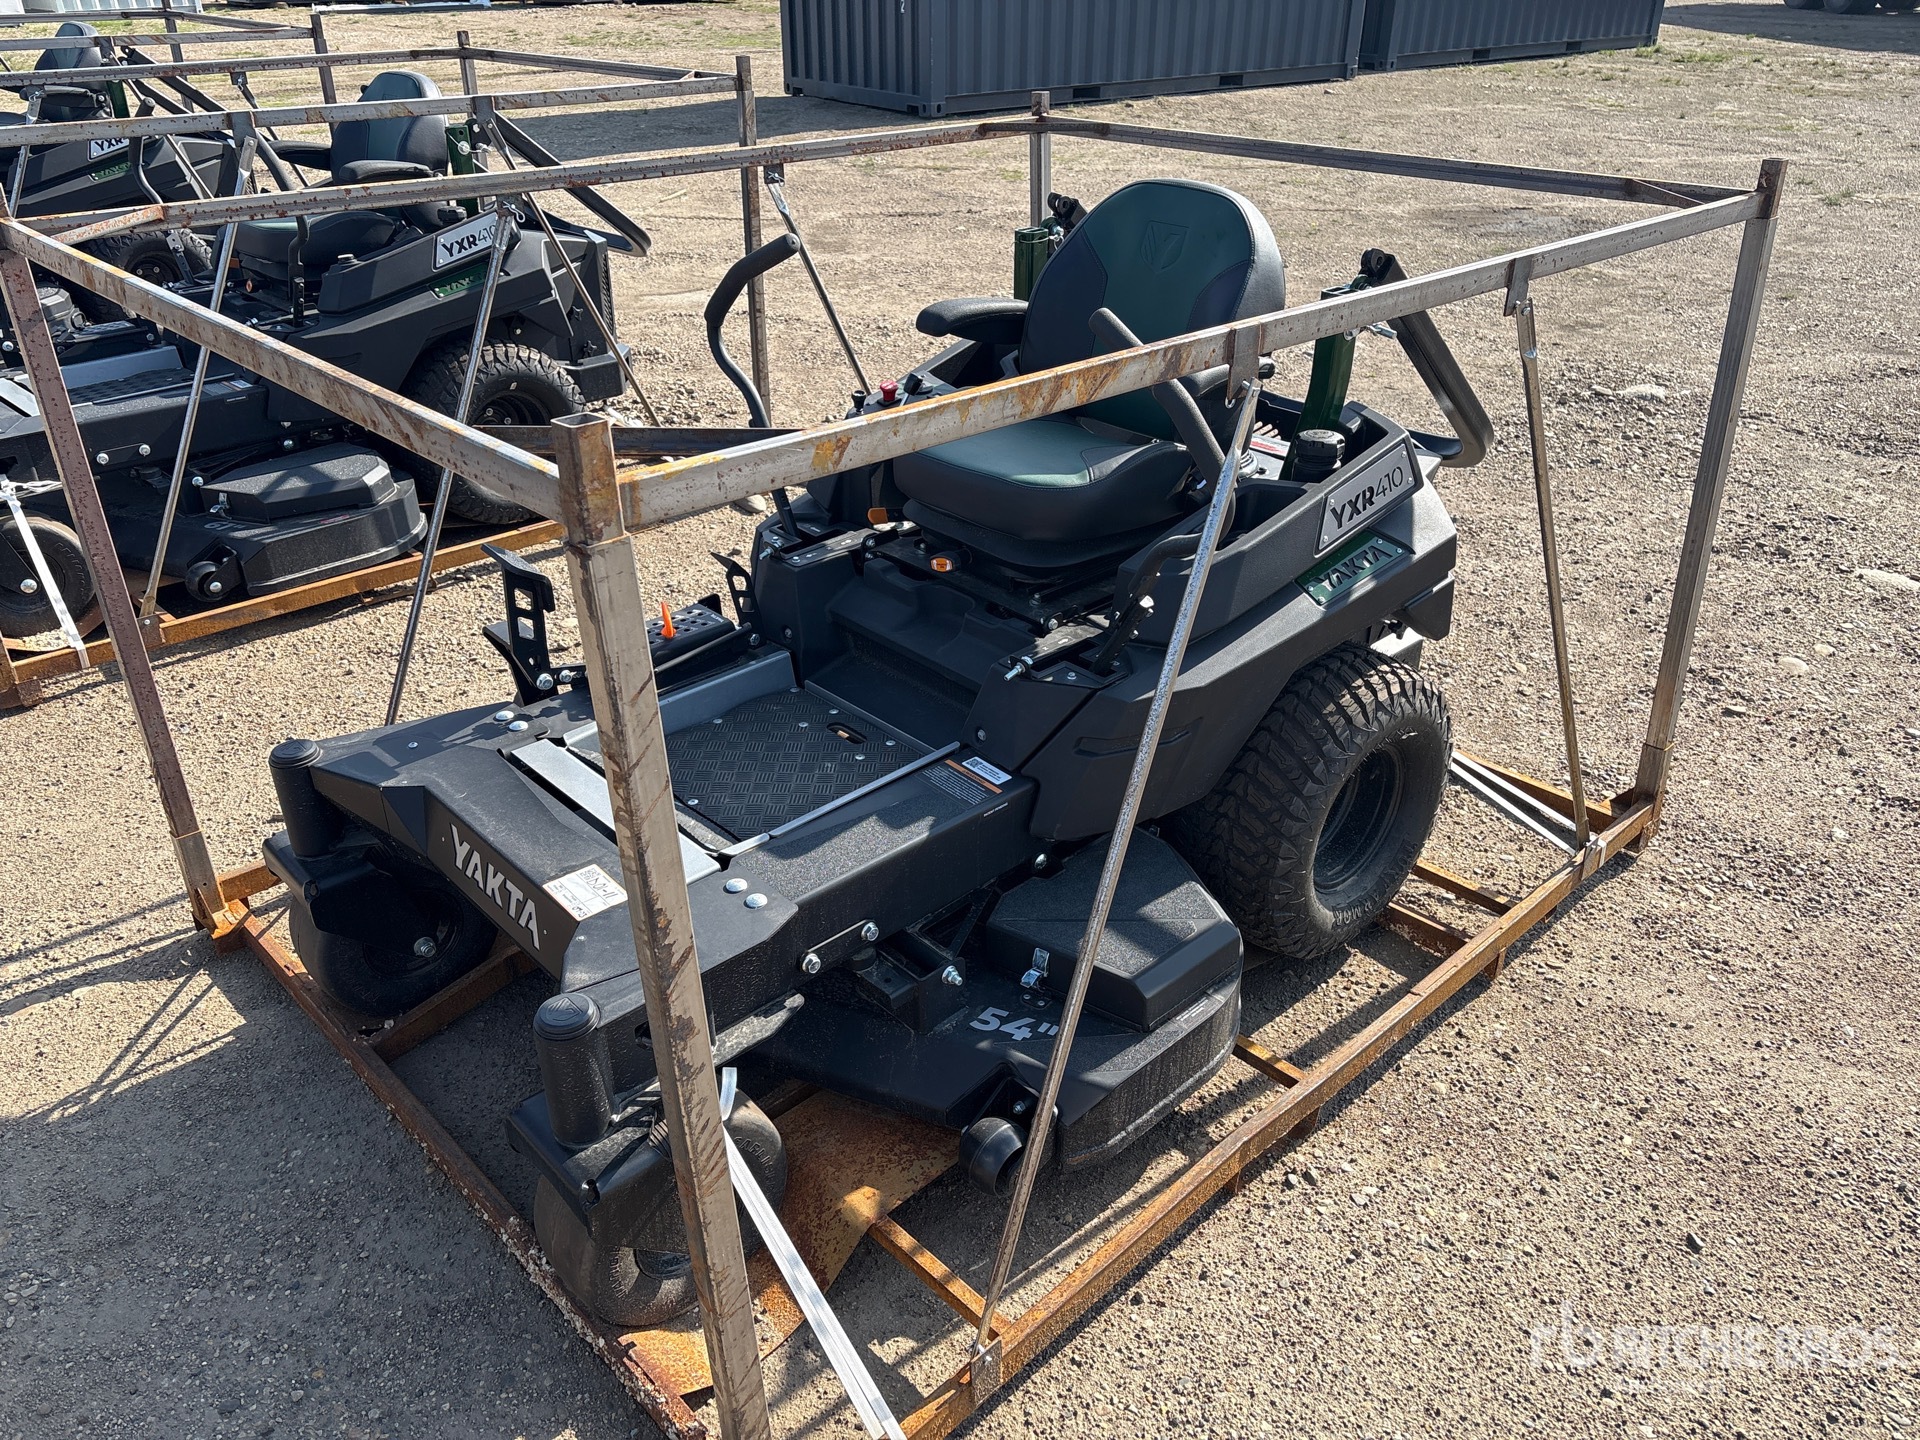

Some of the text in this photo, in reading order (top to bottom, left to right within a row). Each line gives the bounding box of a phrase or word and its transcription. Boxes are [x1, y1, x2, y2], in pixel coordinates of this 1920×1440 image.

[1330, 466, 1404, 530] YXR410
[1313, 545, 1394, 592] YAKTA
[450, 823, 541, 951] YAKTA
[969, 1006, 1059, 1041] 54"
